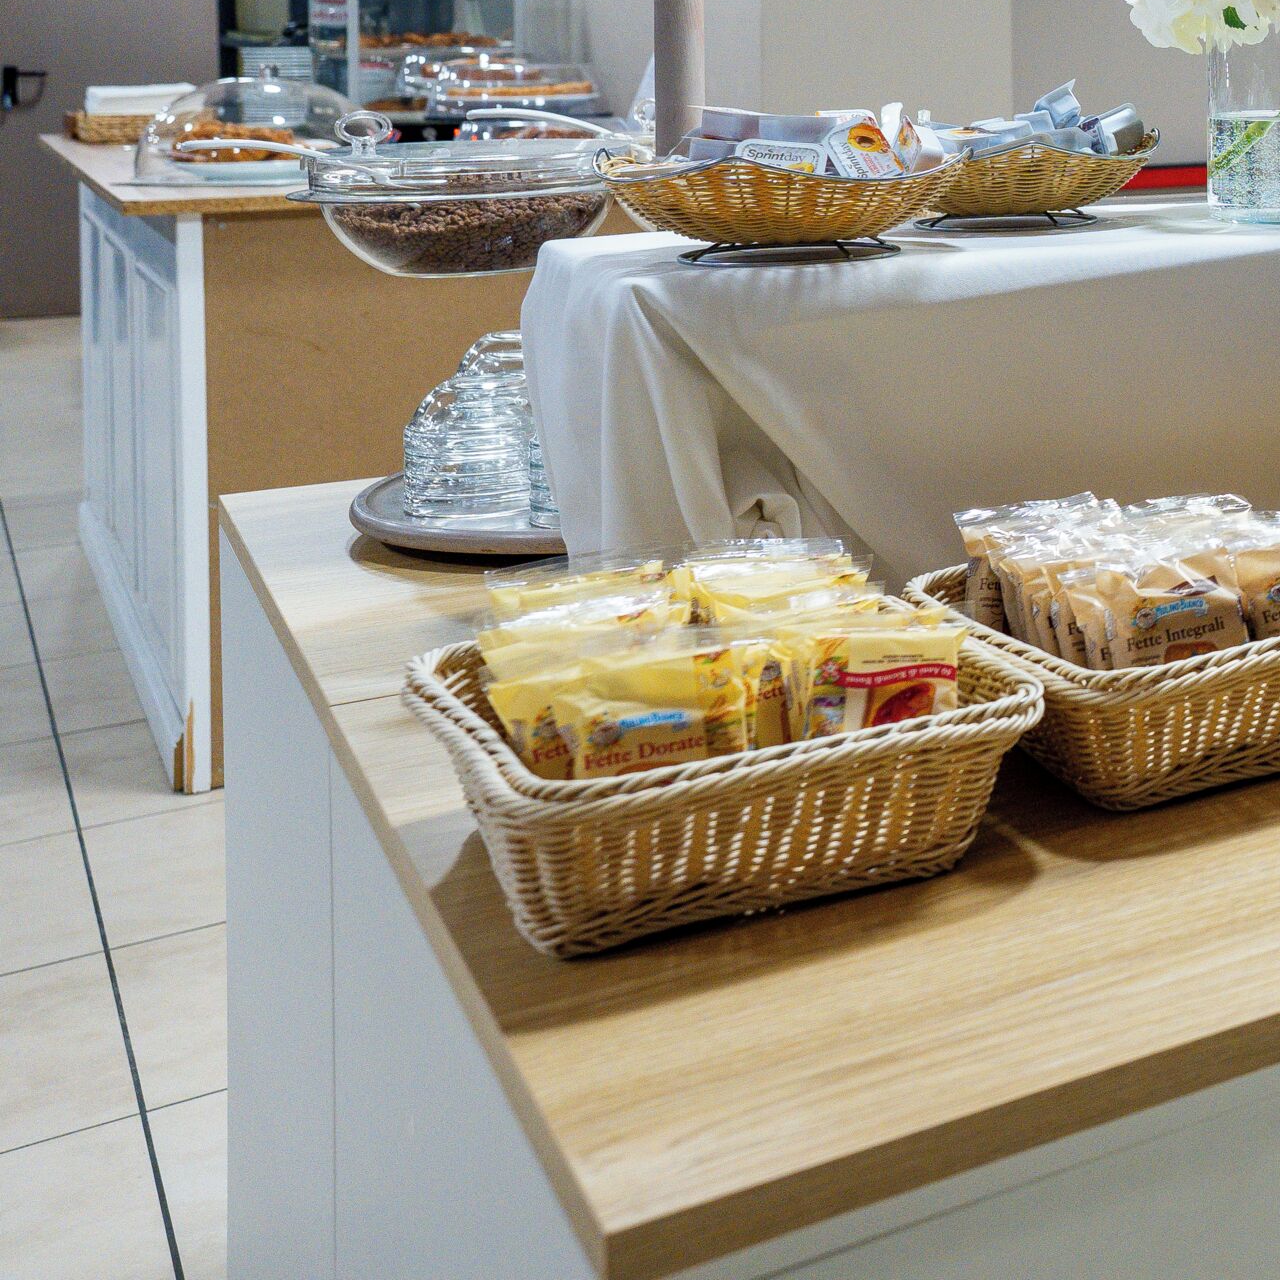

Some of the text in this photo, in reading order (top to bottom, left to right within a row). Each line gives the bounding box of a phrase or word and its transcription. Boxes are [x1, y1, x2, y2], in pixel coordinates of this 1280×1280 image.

[746, 148, 805, 162] Sprintday
[1127, 616, 1226, 652] Fette Integrali
[584, 736, 703, 770] Fette Dorate
